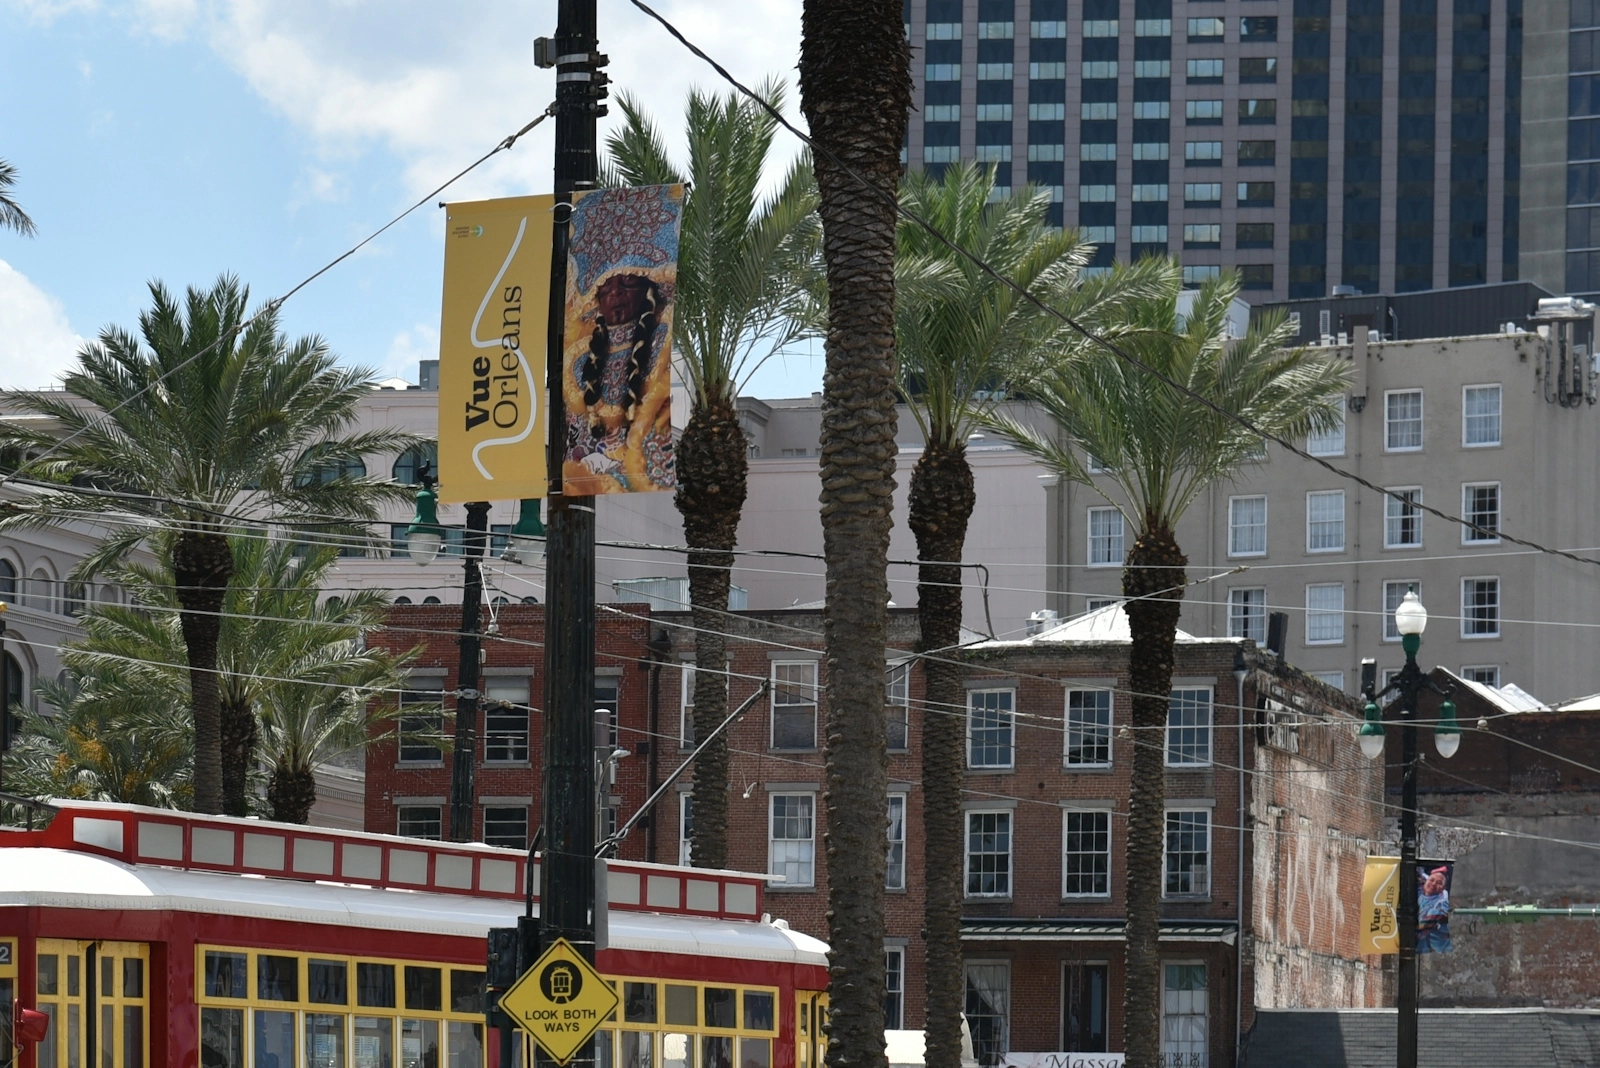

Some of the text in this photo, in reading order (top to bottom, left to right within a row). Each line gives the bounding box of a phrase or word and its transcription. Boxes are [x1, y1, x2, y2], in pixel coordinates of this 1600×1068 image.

[492, 286, 522, 429] Orleans
[465, 356, 491, 432] Vue
[1370, 908, 1381, 933] Vue
[1381, 885, 1395, 934] Orleans
[525, 1009, 596, 1020] LOOK BOTH
[544, 1022, 580, 1032] WAYS
